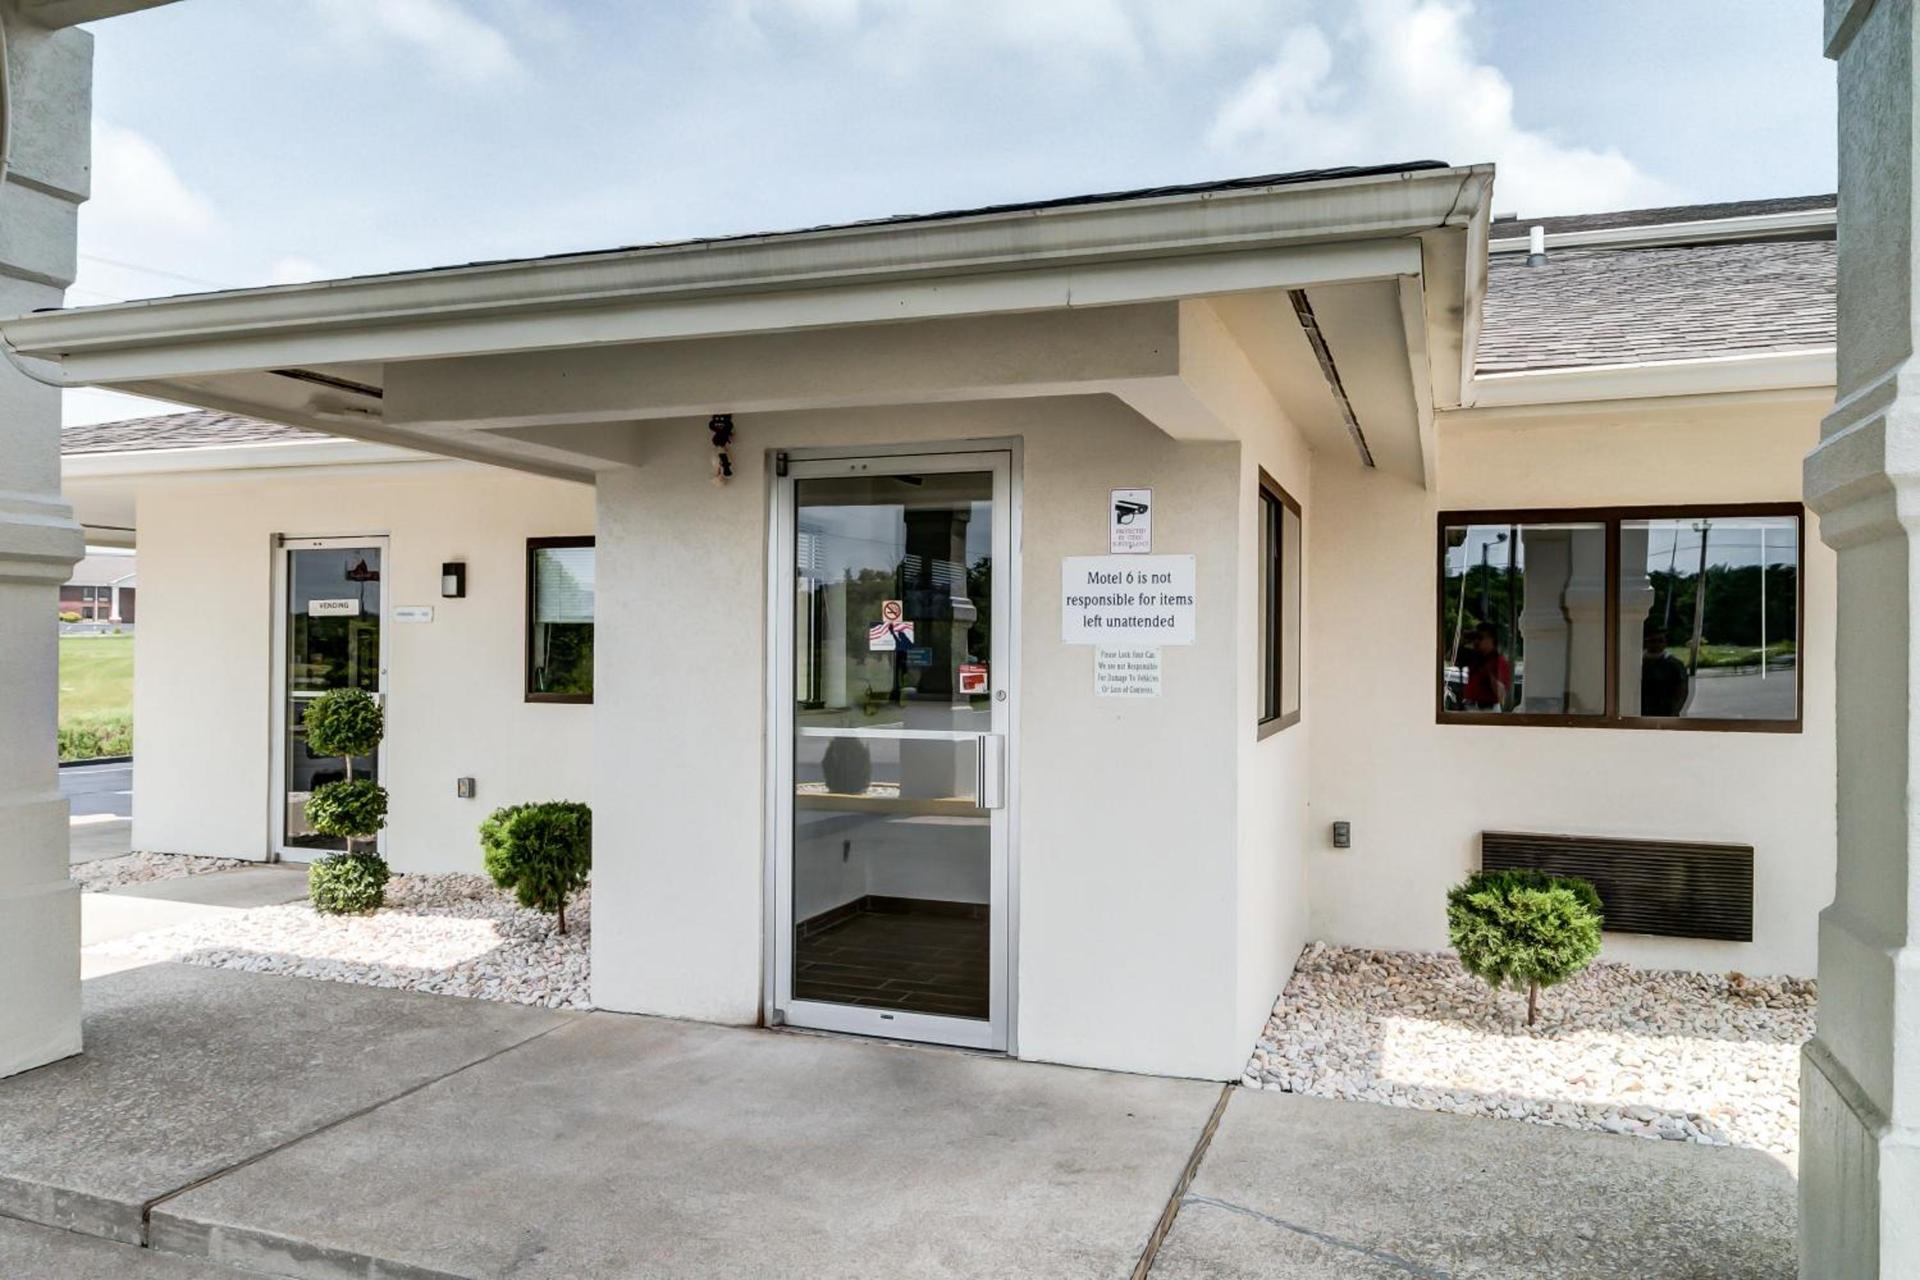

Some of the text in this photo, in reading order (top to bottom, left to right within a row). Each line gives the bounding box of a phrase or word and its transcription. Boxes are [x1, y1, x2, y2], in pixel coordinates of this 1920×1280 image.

[1087, 571, 1172, 585] Motel 6 is not
[1066, 593, 1193, 609] responsible for items
[1083, 615, 1175, 628] left unattended
